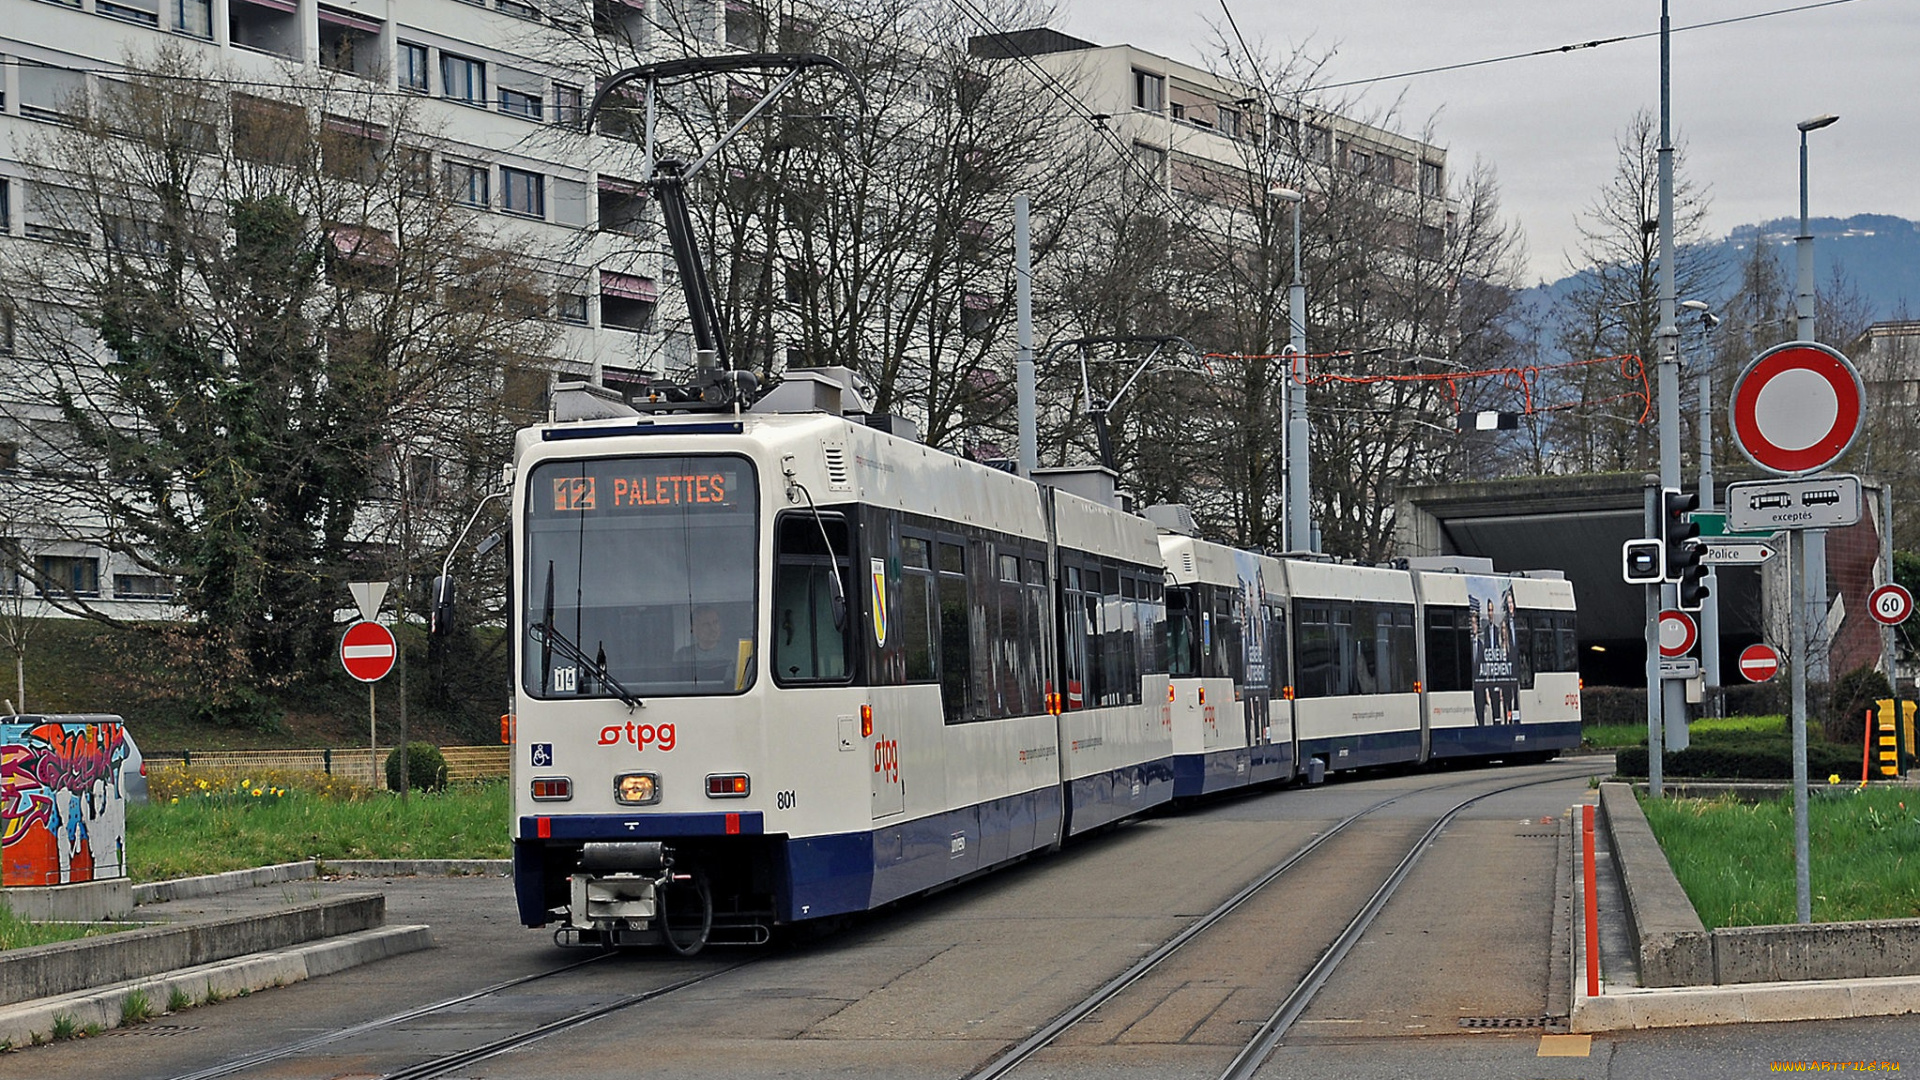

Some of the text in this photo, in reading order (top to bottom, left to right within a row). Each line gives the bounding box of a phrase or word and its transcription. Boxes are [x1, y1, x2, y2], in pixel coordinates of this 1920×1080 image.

[556, 474, 725, 509] 12 PALETTES
[1772, 511, 1813, 522] exceptés
[1708, 549, 1739, 559] Police
[1881, 598, 1900, 613] 60
[776, 790, 797, 810] 801
